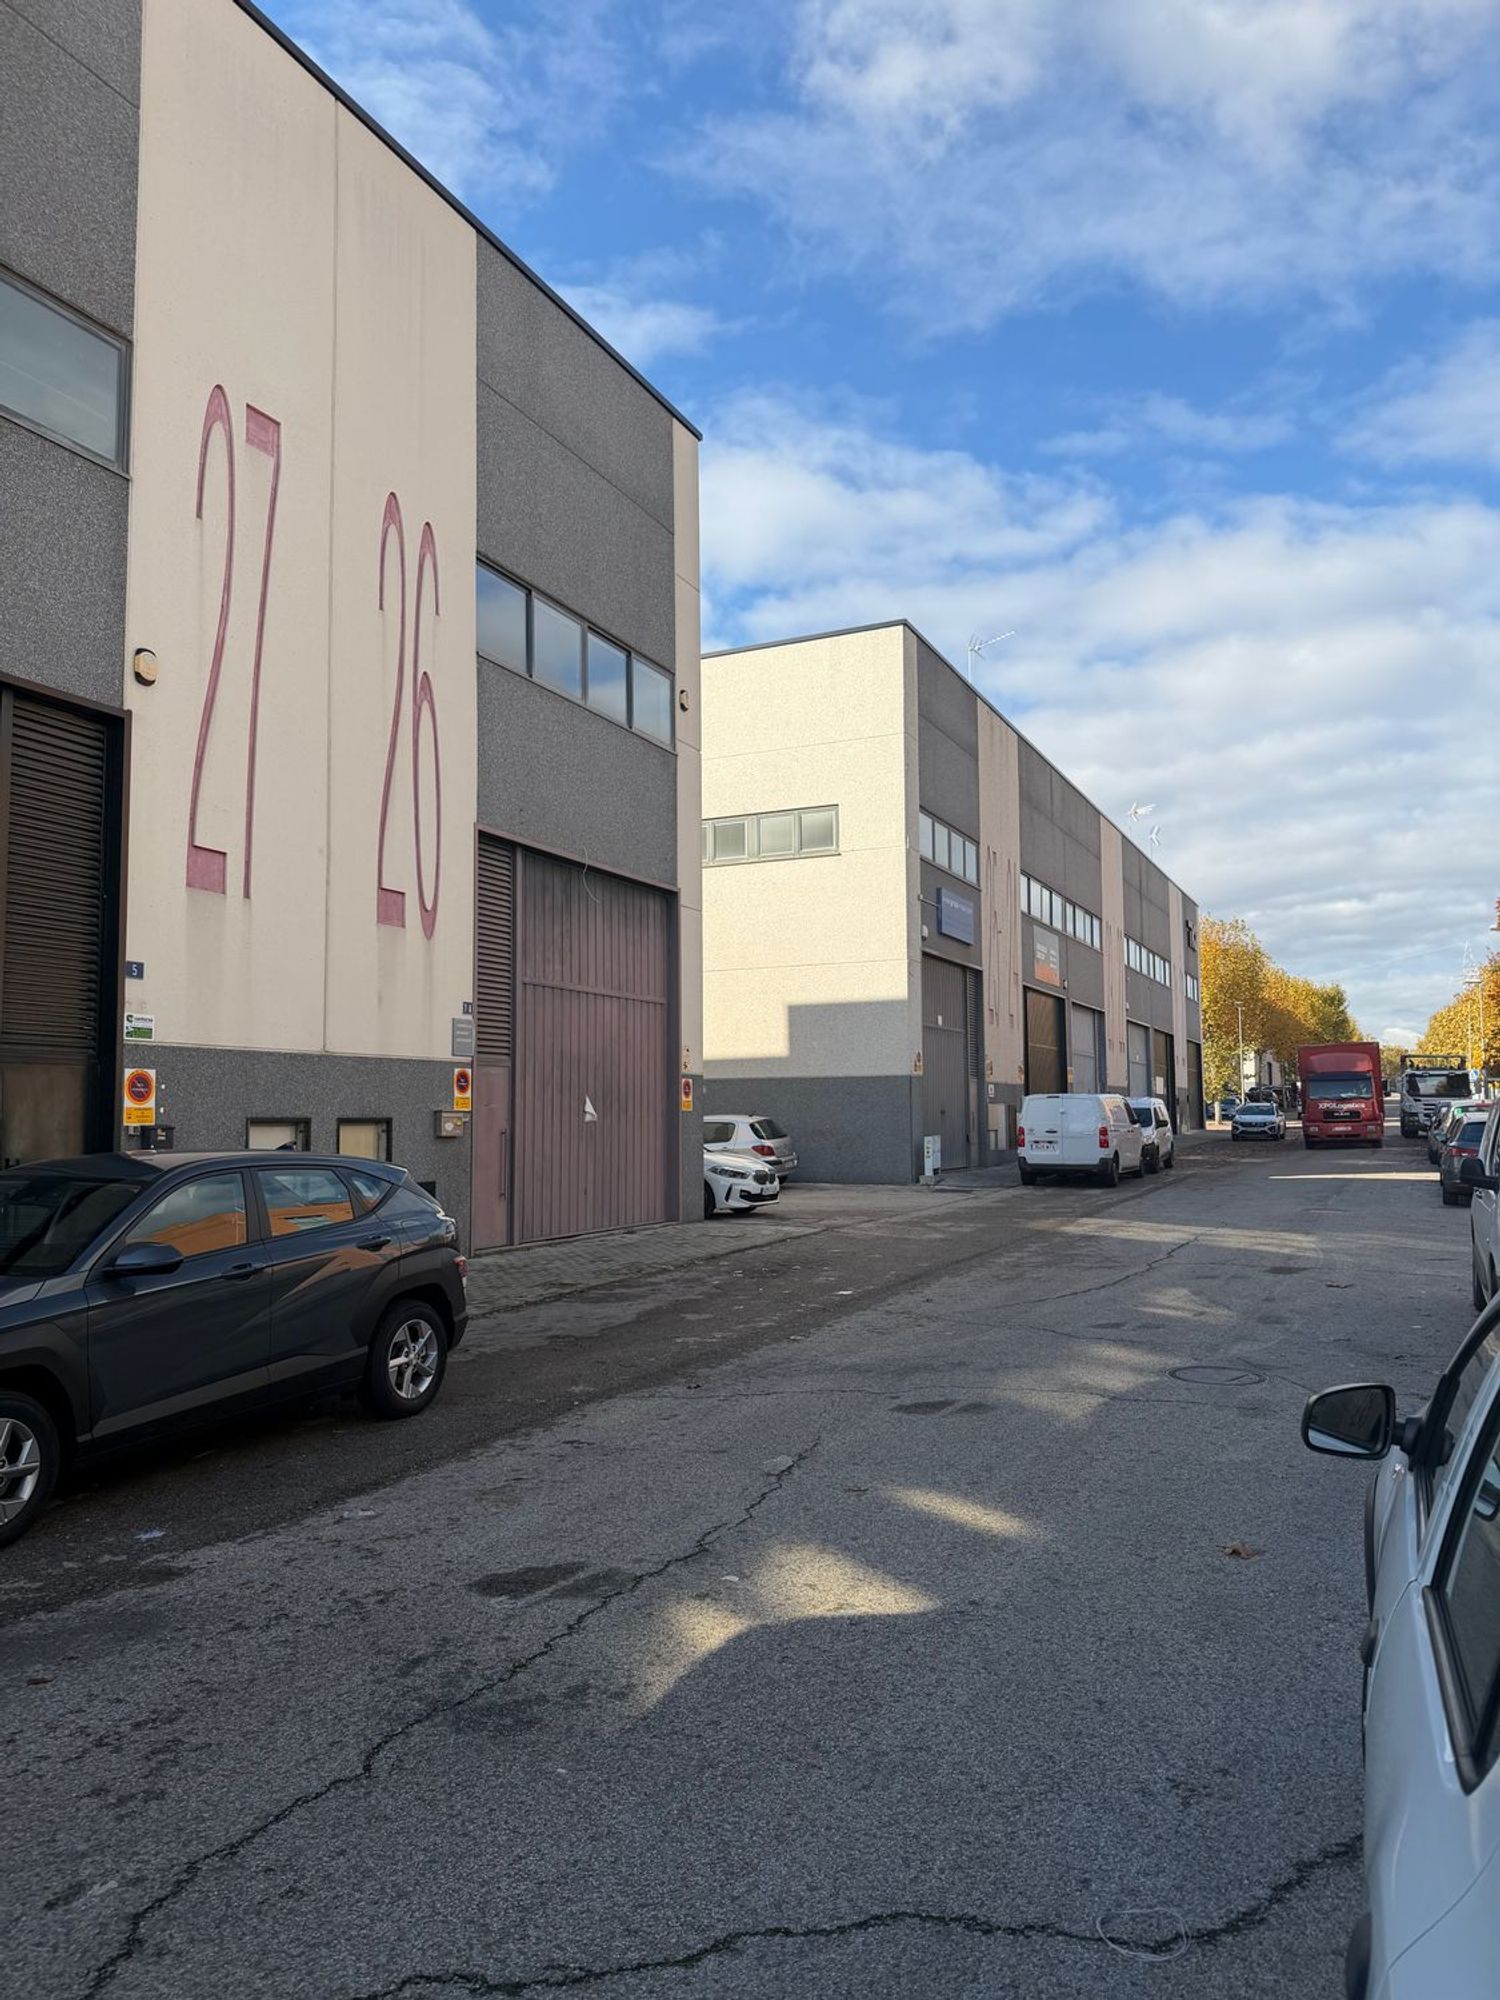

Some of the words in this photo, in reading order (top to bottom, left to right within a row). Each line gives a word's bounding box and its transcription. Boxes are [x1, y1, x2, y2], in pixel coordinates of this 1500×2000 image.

[186, 384, 281, 900] 27
[376, 491, 442, 940] 26
[131, 964, 138, 976] 5
